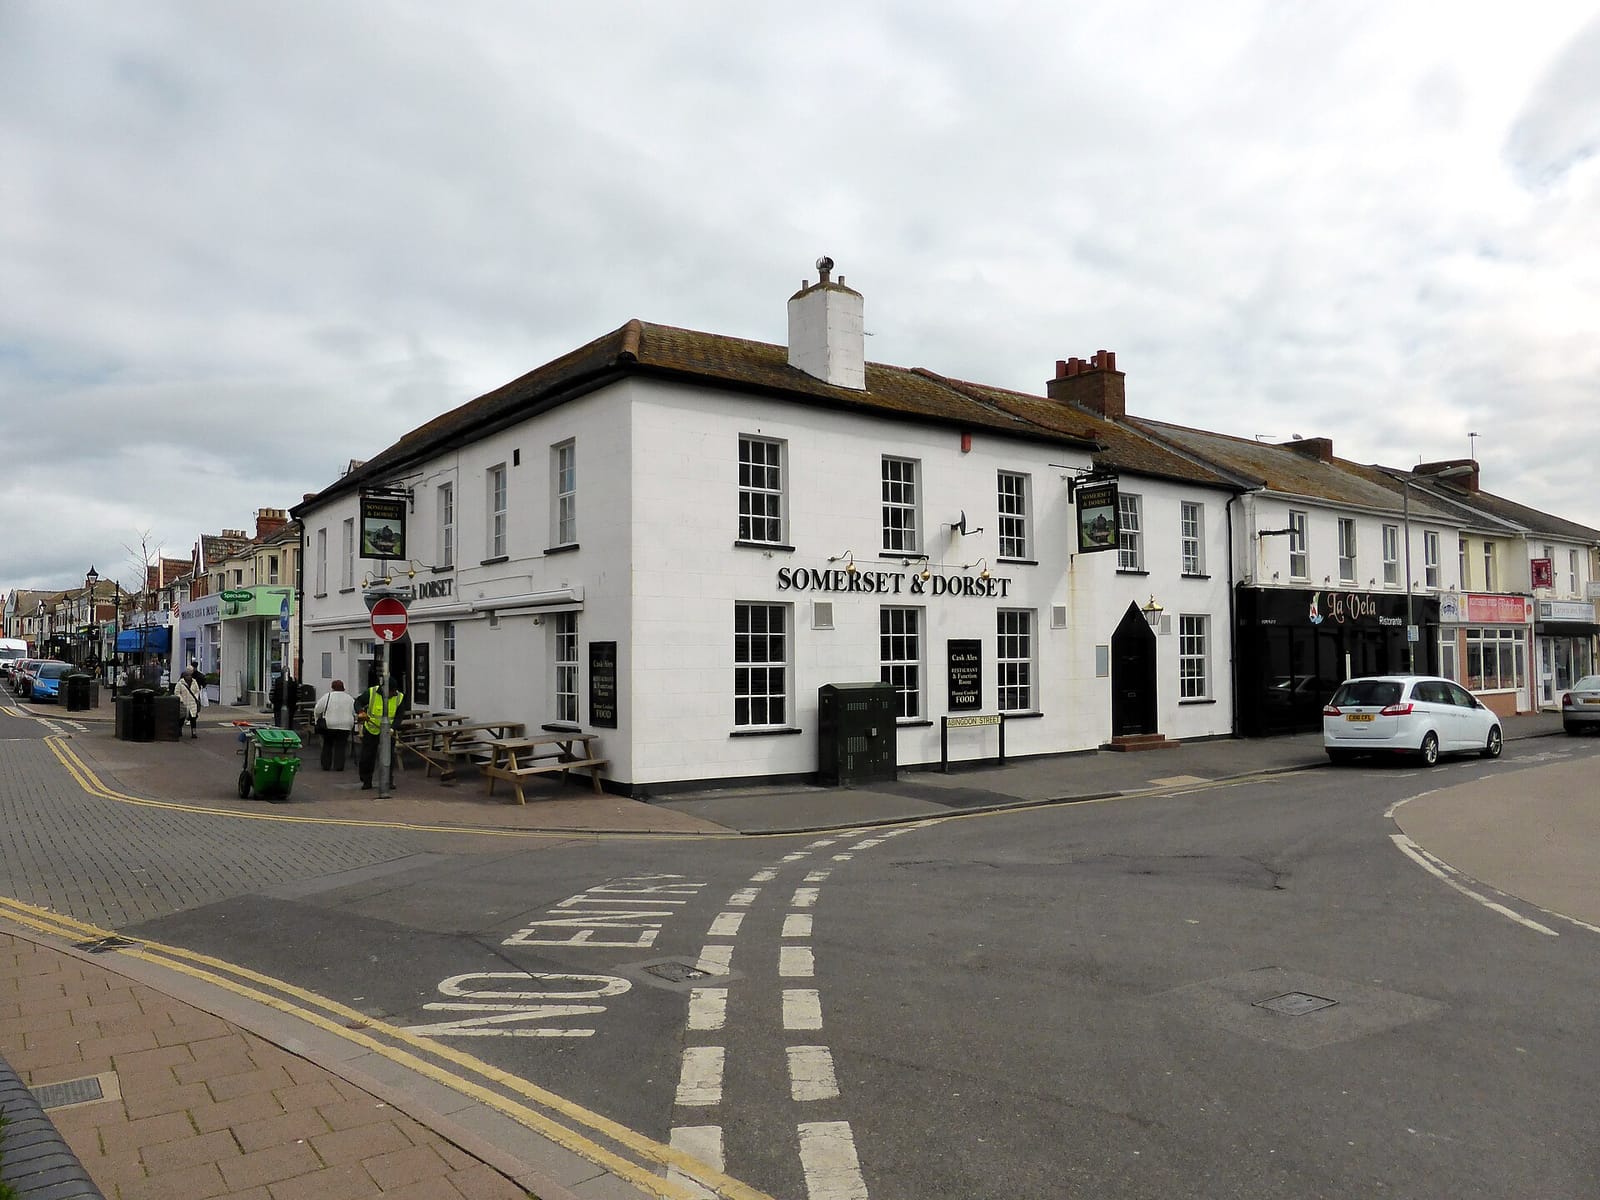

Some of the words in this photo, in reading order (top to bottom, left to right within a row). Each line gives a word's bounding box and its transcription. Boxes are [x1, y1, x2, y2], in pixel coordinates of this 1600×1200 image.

[419, 579, 453, 599] DORSET
[777, 567, 905, 593] SOMERSET
[910, 578, 926, 593] &
[932, 574, 1012, 597] DORSET
[1327, 592, 1345, 623] La
[1346, 594, 1376, 619] Vela
[1379, 615, 1402, 626] Ristorante
[948, 718, 977, 726] ABINGDON
[979, 716, 999, 724] STREET
[398, 972, 632, 1037] NO
